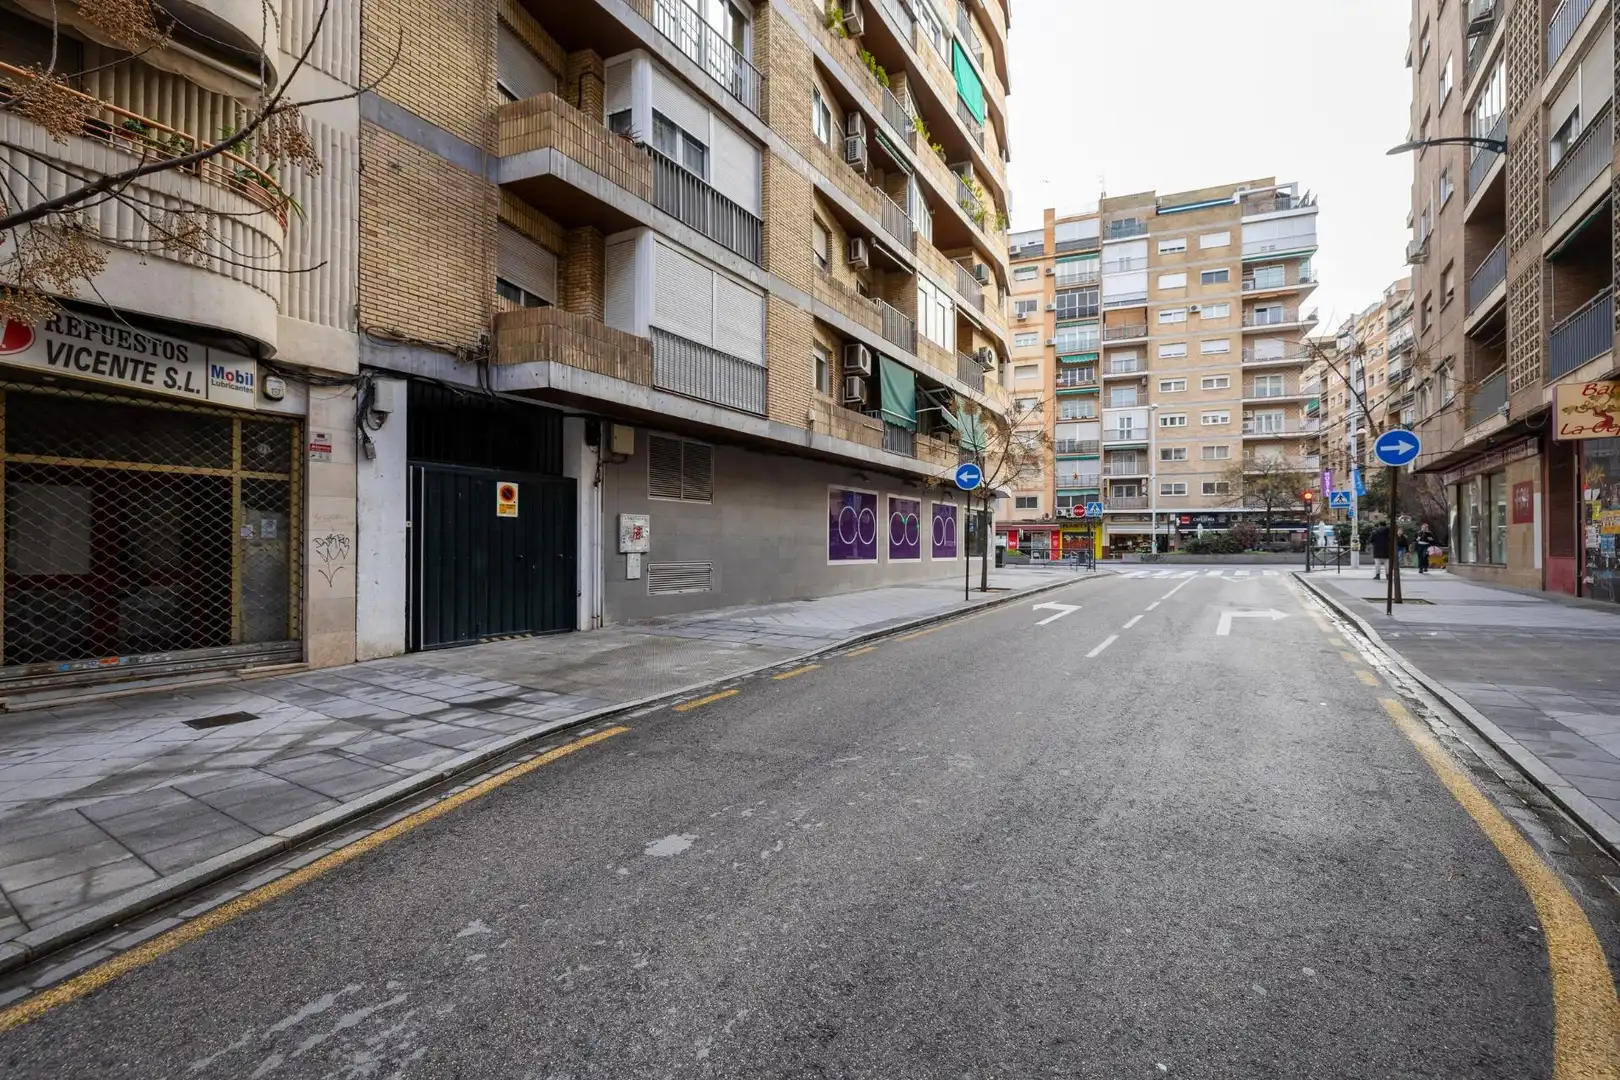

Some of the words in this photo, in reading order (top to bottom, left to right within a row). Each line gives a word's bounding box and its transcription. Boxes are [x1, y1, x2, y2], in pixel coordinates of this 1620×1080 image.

[44, 311, 189, 364] REPUESTOS
[46, 339, 158, 386] VICENTE
[163, 366, 201, 395] S.L.
[211, 364, 254, 387] Mobil
[211, 379, 254, 394] Lubricantes
